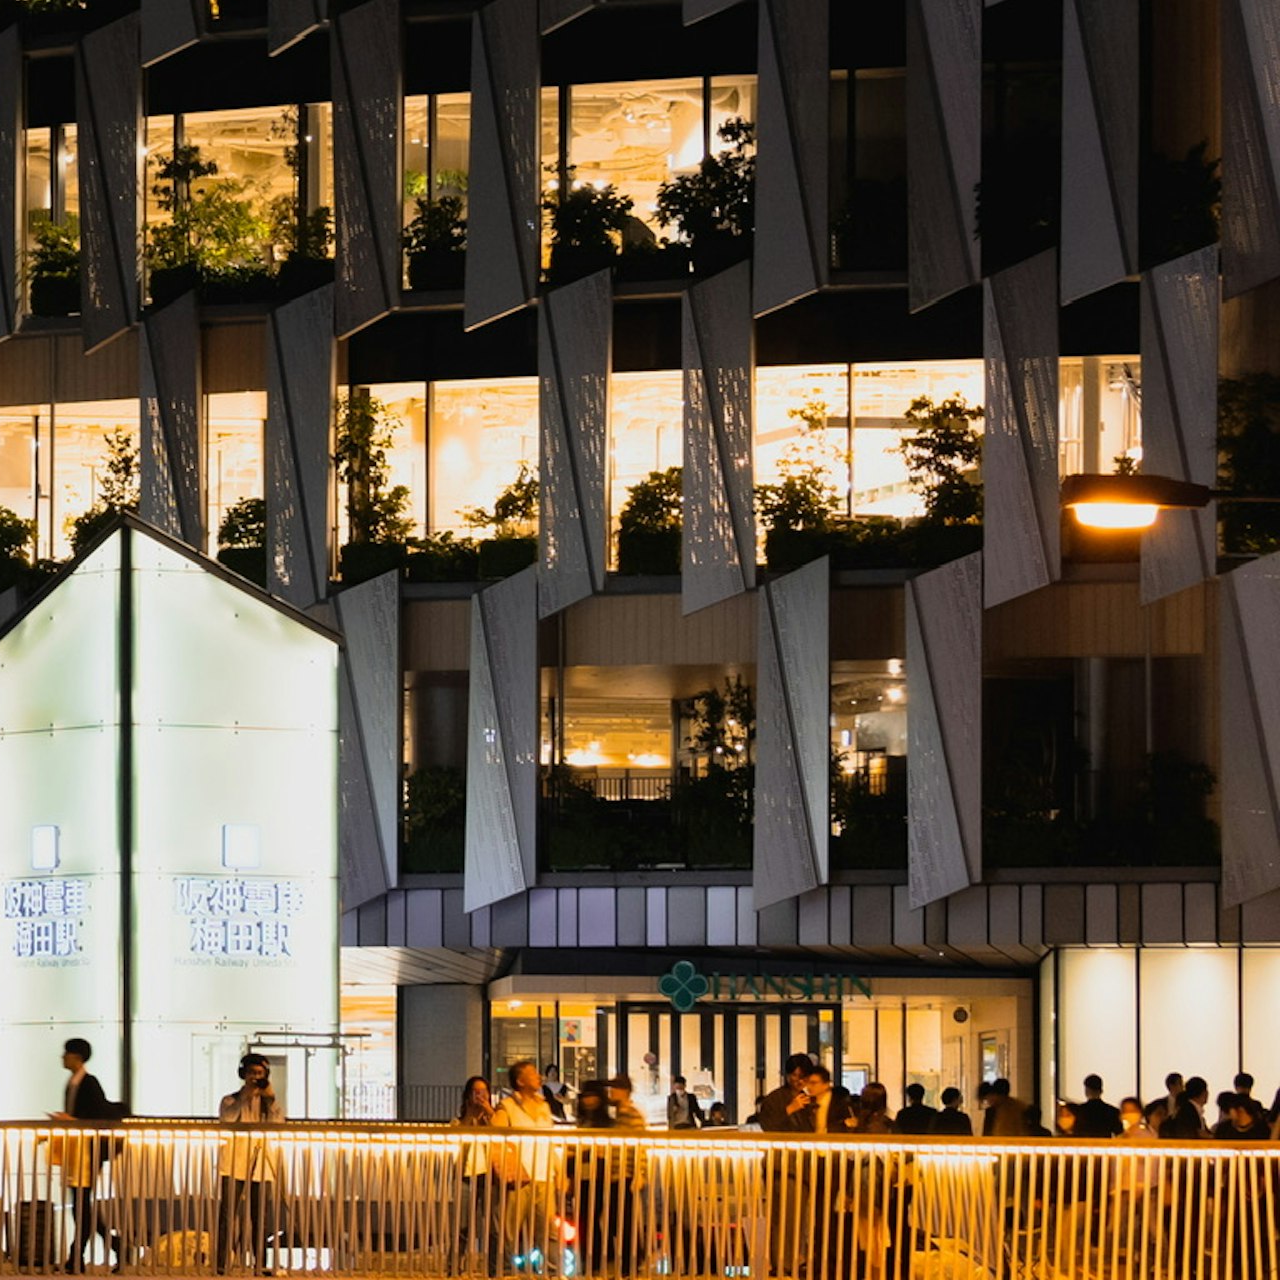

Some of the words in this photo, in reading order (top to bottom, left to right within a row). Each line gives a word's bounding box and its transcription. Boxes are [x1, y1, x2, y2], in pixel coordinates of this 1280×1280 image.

[3, 880, 91, 917] 阪神電車
[175, 878, 304, 916] 阪神電車
[13, 920, 82, 957] 梅田駅
[190, 918, 292, 956] 梅田駅
[713, 971, 872, 1001] HANSHIN
